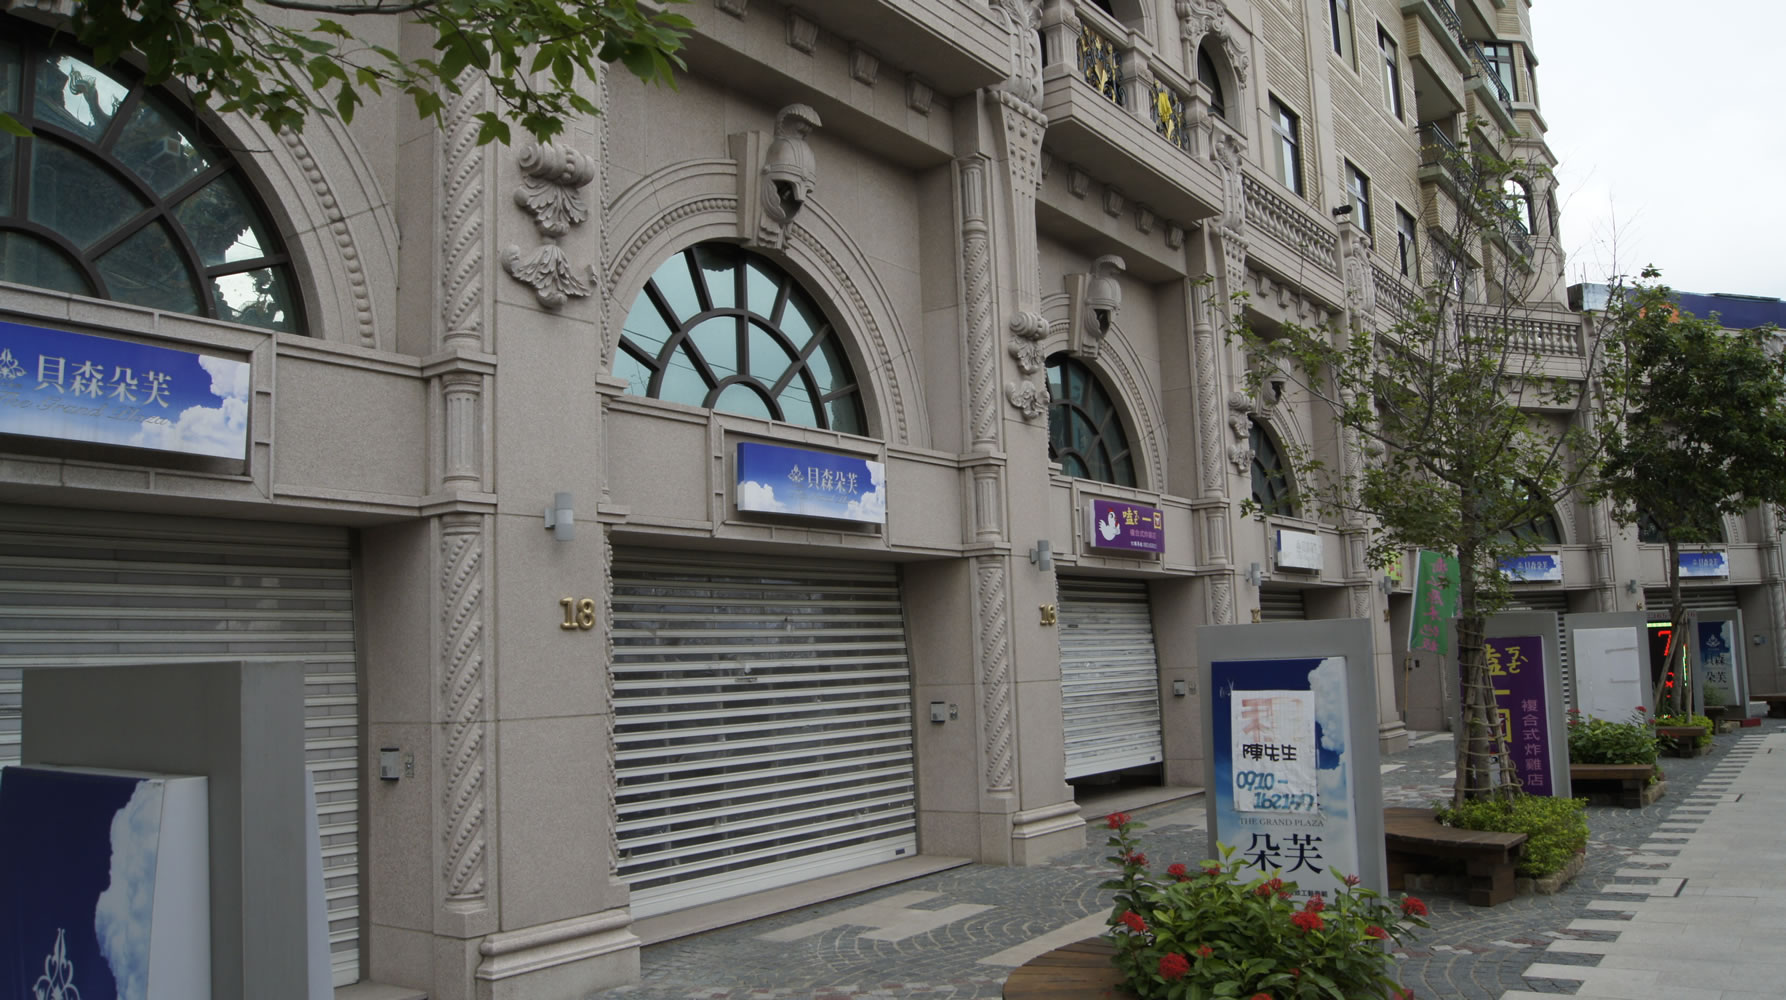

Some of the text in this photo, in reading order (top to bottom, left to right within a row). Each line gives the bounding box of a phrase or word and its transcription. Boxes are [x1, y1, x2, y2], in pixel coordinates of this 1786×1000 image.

[34, 354, 172, 408] 貝森朵芙
[36, 396, 106, 417] Grand
[107, 402, 169, 426] Plaza
[808, 466, 858, 495] 貝森朵芙
[560, 597, 596, 631] 18
[1243, 743, 1297, 762] 陳先生
[1521, 699, 1544, 787] 複合式炸雞店
[1240, 817, 1324, 827] THE GRAND PLAZA
[1243, 833, 1324, 874] 朵芙
